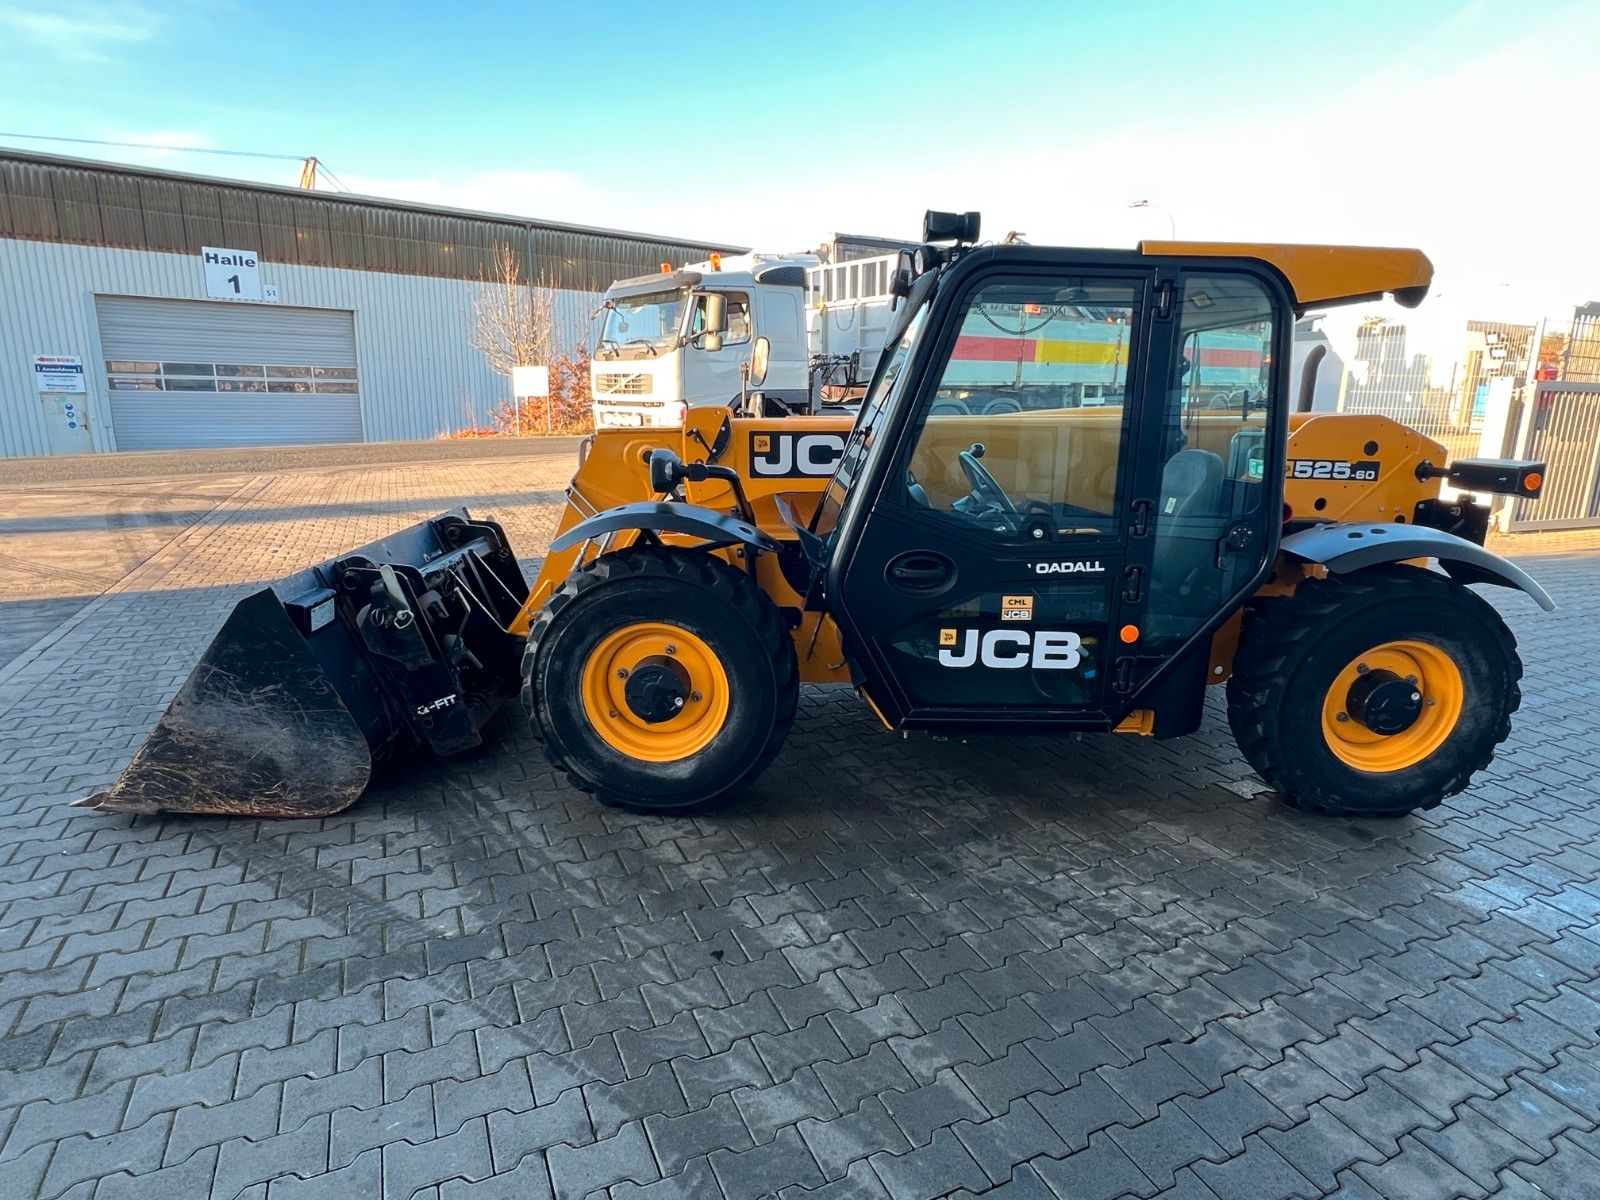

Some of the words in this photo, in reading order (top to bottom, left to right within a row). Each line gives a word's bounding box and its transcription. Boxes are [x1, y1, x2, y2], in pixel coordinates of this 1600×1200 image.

[205, 252, 256, 268] Halle
[227, 274, 241, 293] 1
[754, 434, 845, 475] JC
[1026, 561, 1105, 574] OADALL
[1004, 610, 1029, 618] JCB
[938, 629, 1081, 670] JCB
